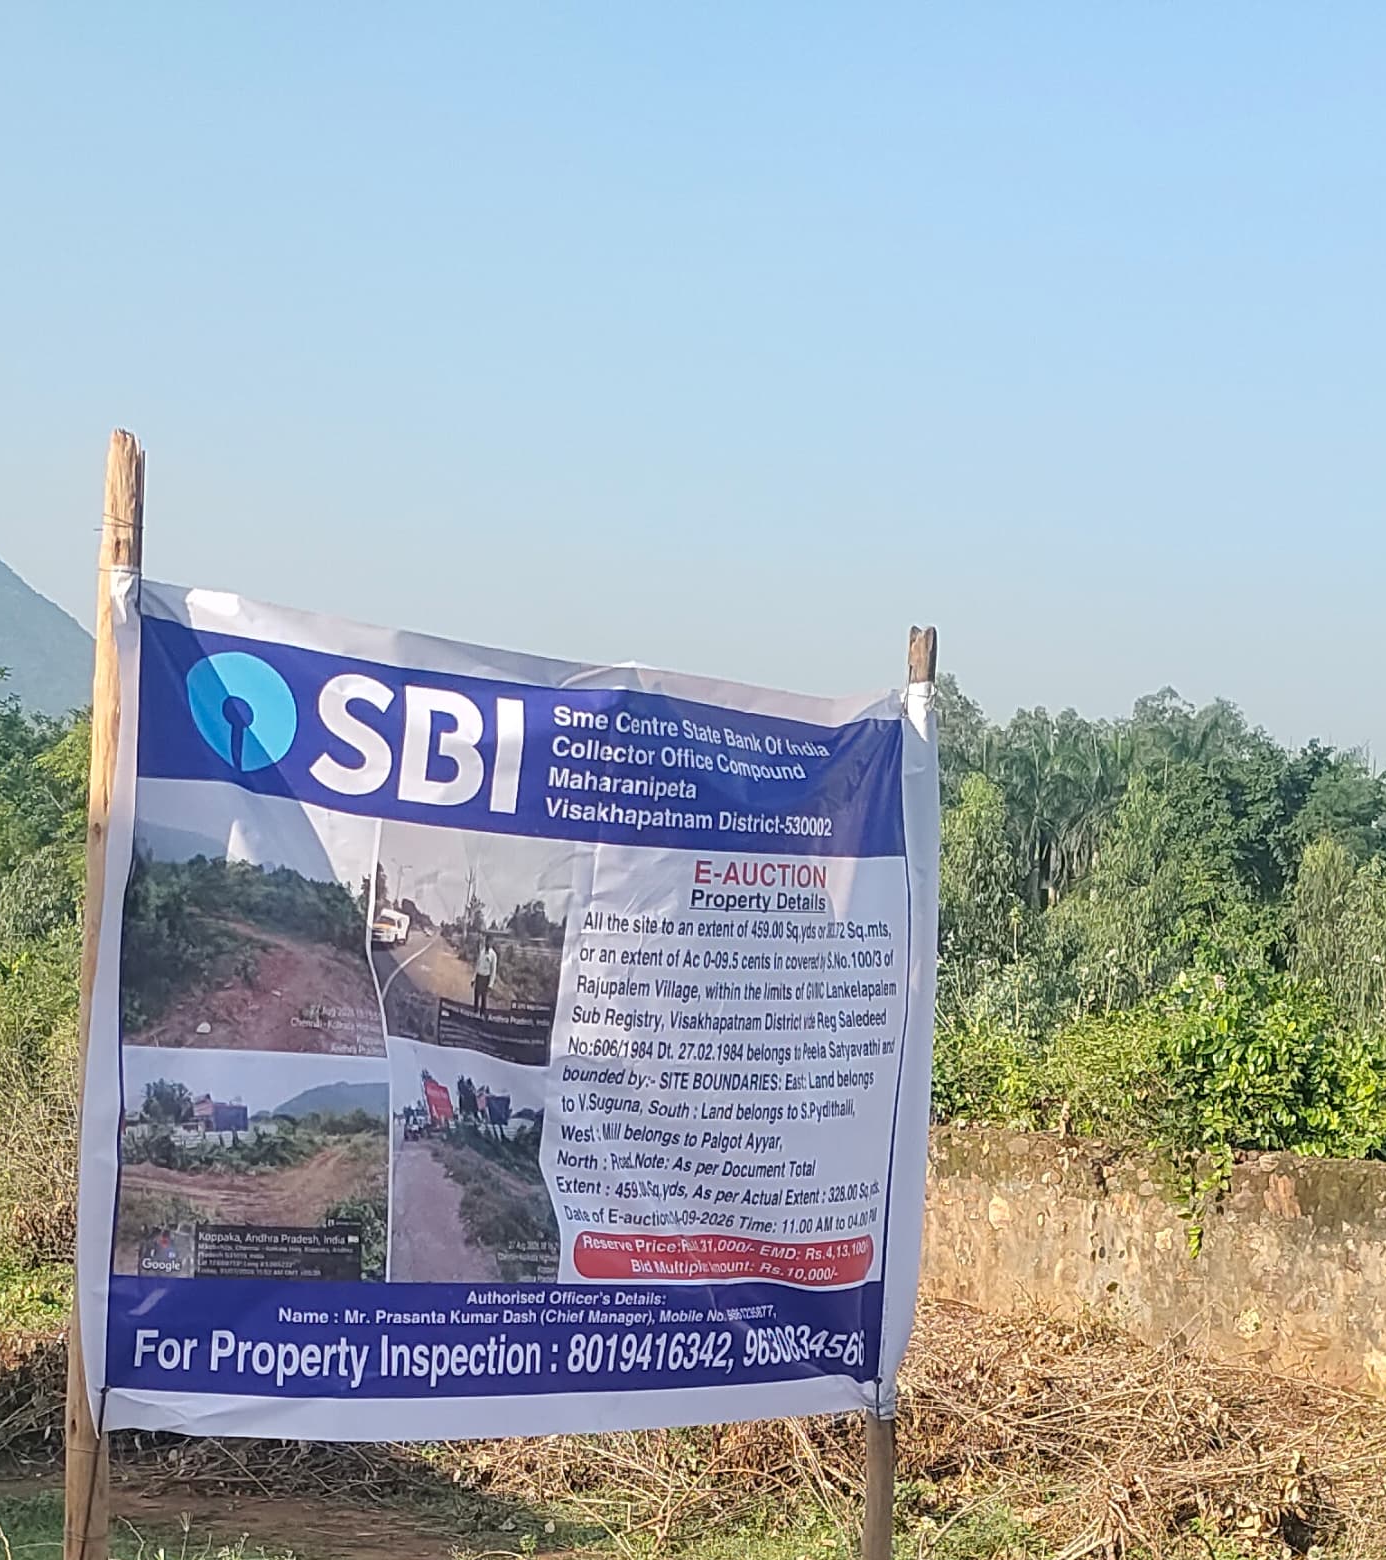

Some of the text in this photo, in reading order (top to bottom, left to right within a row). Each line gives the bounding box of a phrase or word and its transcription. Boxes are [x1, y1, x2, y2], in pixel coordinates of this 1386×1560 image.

[309, 673, 524, 814] SBI
[553, 705, 830, 757] Sme Centre State Bank Of India
[552, 736, 806, 781] Collector Office Compound
[548, 766, 697, 801] Maharanipeta
[545, 797, 832, 837] Visakhapatnam District-530002
[694, 860, 827, 889] E-AUCTION
[690, 889, 826, 912] Property Details
[583, 912, 602, 931] All
[607, 913, 629, 933] the
[632, 915, 658, 934] site
[661, 917, 674, 935] to
[677, 921, 693, 936] an
[697, 919, 734, 938] extent
[737, 920, 748, 938] of
[751, 920, 783, 938] 459.00
[786, 920, 816, 944] Sq.yds
[817, 925, 826, 939] or
[847, 921, 892, 943] Sq.mts,
[579, 947, 594, 962] or
[599, 947, 616, 964] an
[621, 950, 662, 966] extent
[666, 951, 680, 967] of
[682, 951, 700, 968] Ac
[703, 950, 739, 969] 0-09.5
[741, 953, 771, 970] cents
[773, 952, 783, 970] in
[884, 949, 894, 967] of
[576, 975, 650, 1000] Rajupalem
[655, 979, 701, 1003] Village,
[705, 982, 741, 1000] within
[744, 982, 762, 1000] the
[764, 981, 792, 1000] limits
[795, 981, 805, 1000] of
[826, 979, 897, 1001] Lankelapalem
[571, 1005, 601, 1025] Sub
[604, 1008, 665, 1032] Registry,
[670, 1010, 762, 1034] Visakhapatnam
[765, 1012, 802, 1031] District
[817, 1011, 837, 1033] Reg
[838, 1008, 887, 1029] Saledeed
[568, 1036, 654, 1059] No:606/1984
[657, 1042, 674, 1060] Dt.
[678, 1042, 743, 1061] 27.02.1984
[746, 1043, 791, 1065] belongs
[794, 1044, 802, 1061] to
[828, 1038, 881, 1062] Satyavathi
[882, 1037, 895, 1055] and
[562, 1065, 875, 1092] bounded by:- SITE BOUNDARIES: East: Land belongs
[561, 1095, 575, 1113] to
[578, 1092, 643, 1115] V.Suguna,
[647, 1100, 690, 1119] South
[701, 1102, 733, 1120] Land
[736, 1103, 783, 1124] belongs
[787, 1103, 798, 1120] to
[561, 1124, 595, 1142] West
[624, 1123, 681, 1147] belongs
[683, 1132, 698, 1148] to
[701, 1131, 743, 1153] Palgot
[744, 1132, 783, 1154] Ayyar,
[557, 1150, 598, 1170] North
[671, 1156, 692, 1172] As
[694, 1160, 719, 1177] per
[721, 1160, 786, 1178] Document
[789, 1159, 817, 1177] Total
[556, 1175, 602, 1194] Extent
[692, 1184, 713, 1200] As
[714, 1190, 740, 1207] per
[740, 1188, 783, 1206] Actual
[784, 1188, 819, 1206] Extent
[828, 1184, 857, 1202] 328.00
[563, 1205, 591, 1222] Date
[593, 1206, 605, 1224] of
[739, 1216, 777, 1234] Time:
[782, 1218, 813, 1235] 11.00
[815, 1216, 833, 1233] AM
[835, 1215, 845, 1230] to
[582, 1235, 633, 1251] Reserve
[759, 1244, 801, 1260] EMD:
[142, 1258, 181, 1272] Google
[630, 1258, 653, 1274] Bid
[467, 1289, 666, 1305] Authorised Officer's Details:
[278, 1307, 329, 1323] Name
[344, 1309, 371, 1323] Mr.
[376, 1310, 446, 1324] Prasanta
[450, 1310, 499, 1324] Kumar
[503, 1310, 536, 1324] Dash
[540, 1309, 585, 1326] (Chief
[588, 1310, 655, 1326] Manager),
[659, 1310, 703, 1323] Mobile
[134, 1329, 198, 1371] For
[210, 1329, 369, 1389] Property
[381, 1333, 541, 1388] Inspection
[567, 1331, 734, 1375] 8019416342,
[743, 1325, 865, 1367] 9630834566
